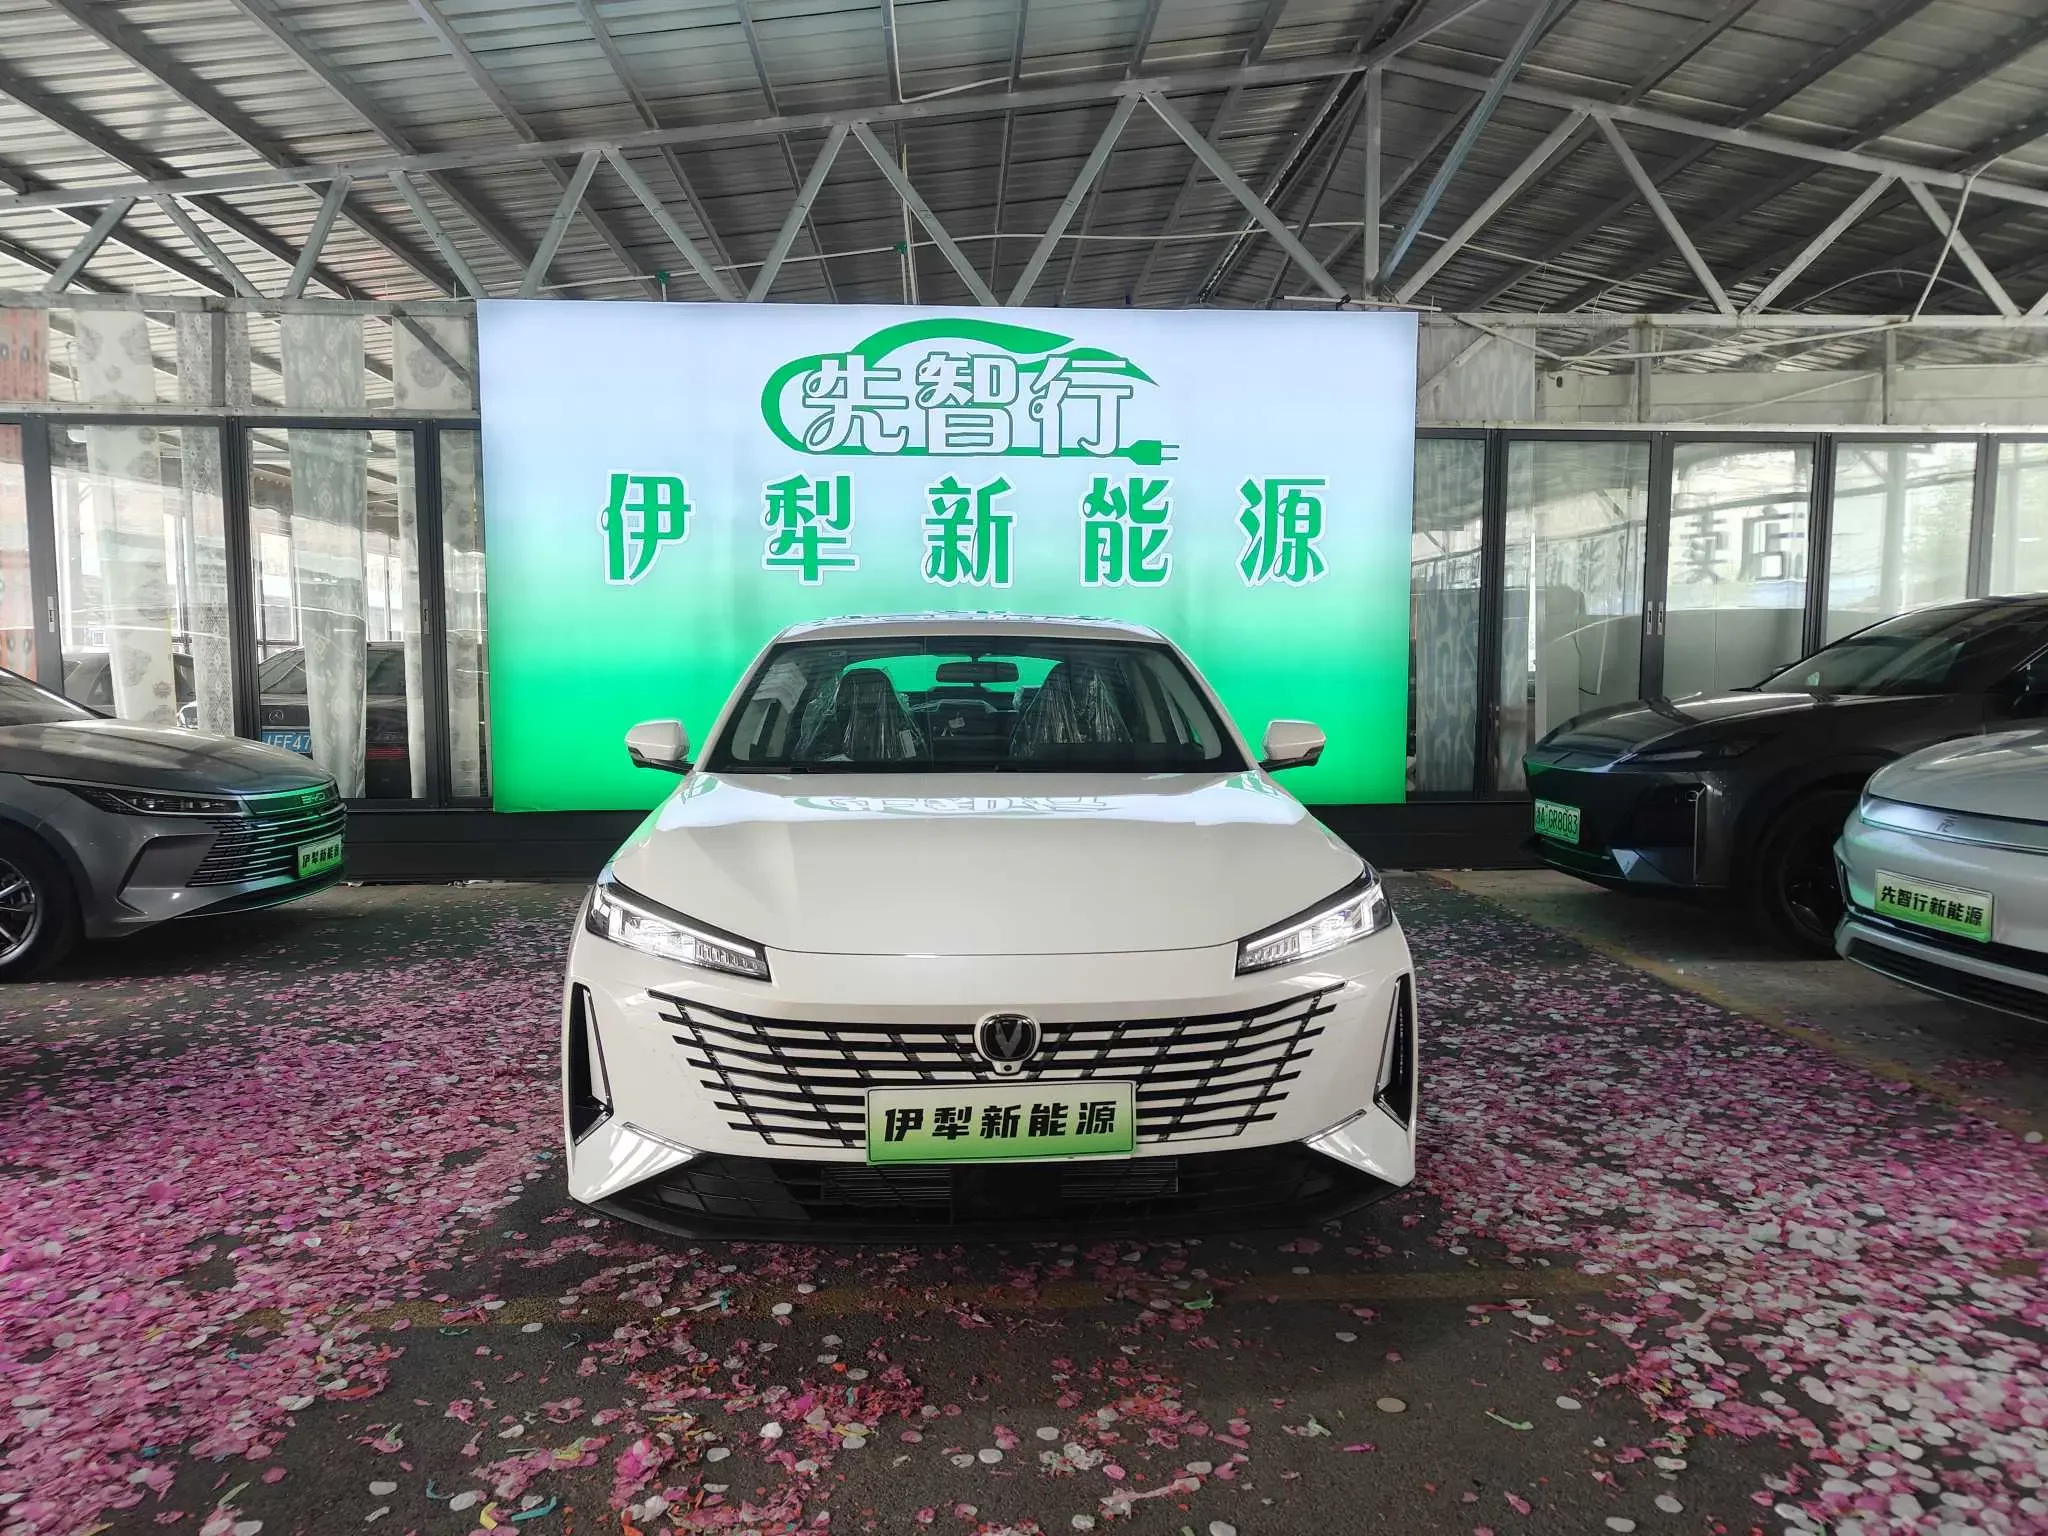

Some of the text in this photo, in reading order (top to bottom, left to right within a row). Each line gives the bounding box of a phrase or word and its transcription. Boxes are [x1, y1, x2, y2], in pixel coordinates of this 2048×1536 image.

[803, 352, 1134, 457] 先智行
[599, 472, 1328, 584] 伊犁新能源
[1880, 886, 1984, 926] 先智行新能源
[884, 1100, 1118, 1142] 伊犁新能源
